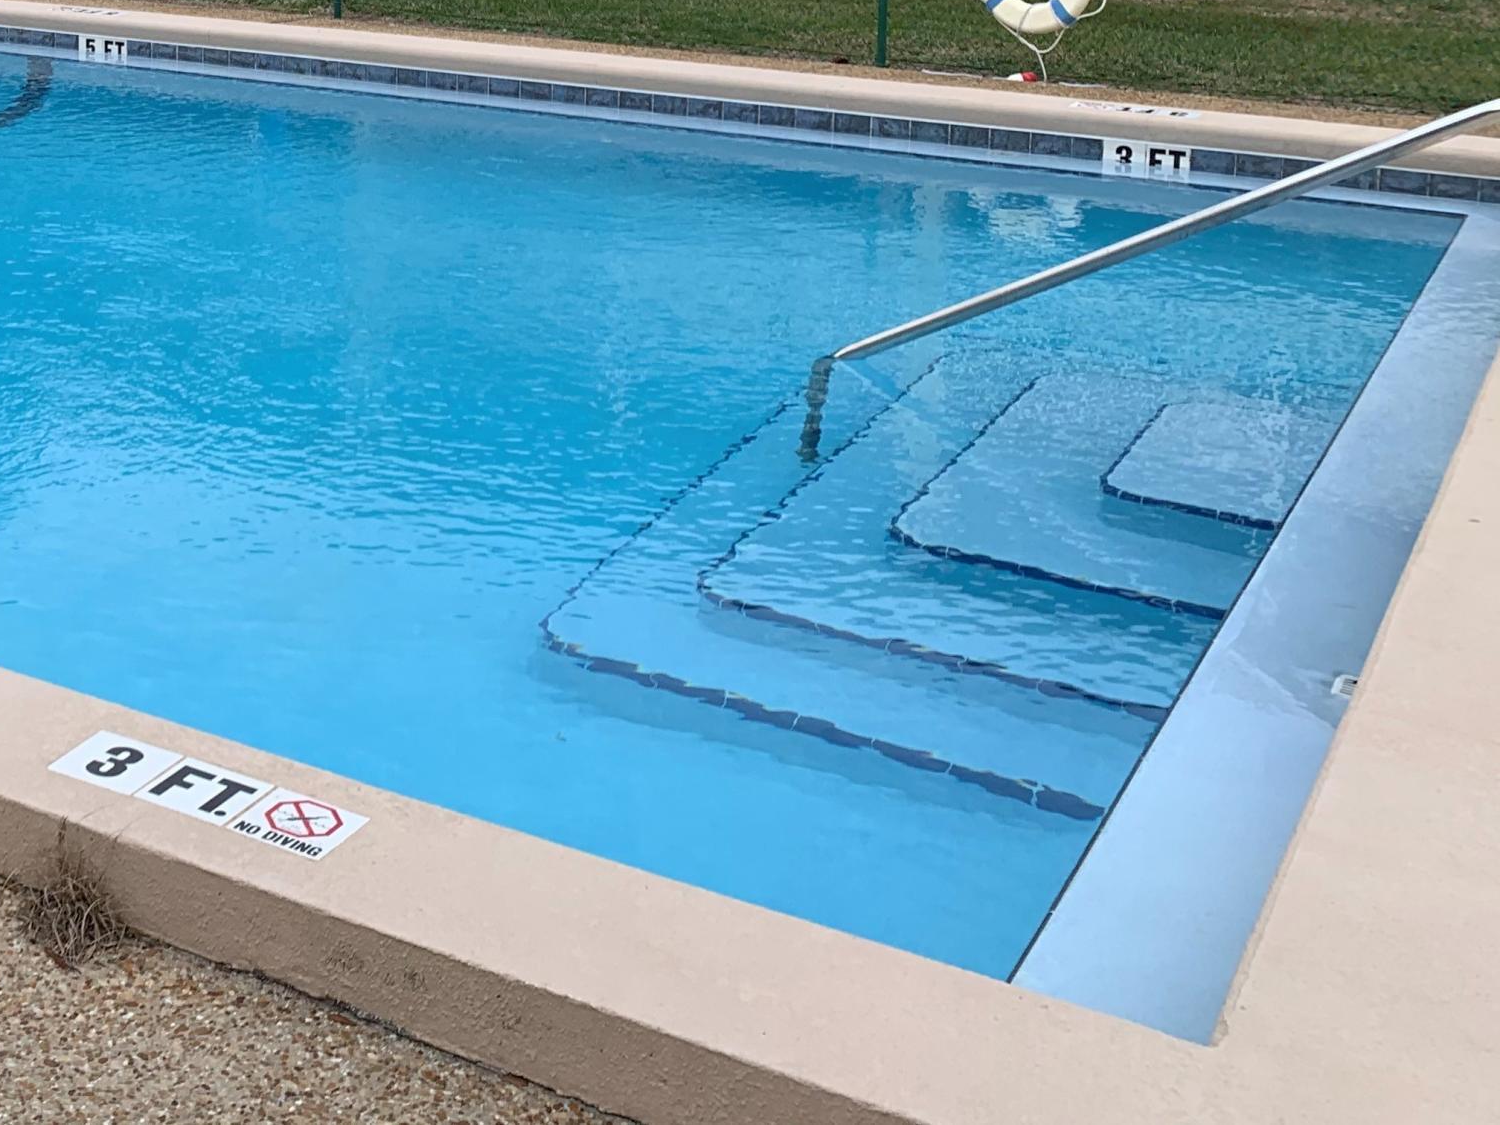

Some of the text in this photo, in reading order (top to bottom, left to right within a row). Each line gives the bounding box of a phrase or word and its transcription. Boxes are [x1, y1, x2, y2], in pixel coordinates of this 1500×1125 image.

[86, 38, 124, 56] 5 FT
[1115, 145, 1186, 170] 3 FT
[85, 746, 259, 817] 3 FT.
[233, 819, 323, 858] NO DIVING
